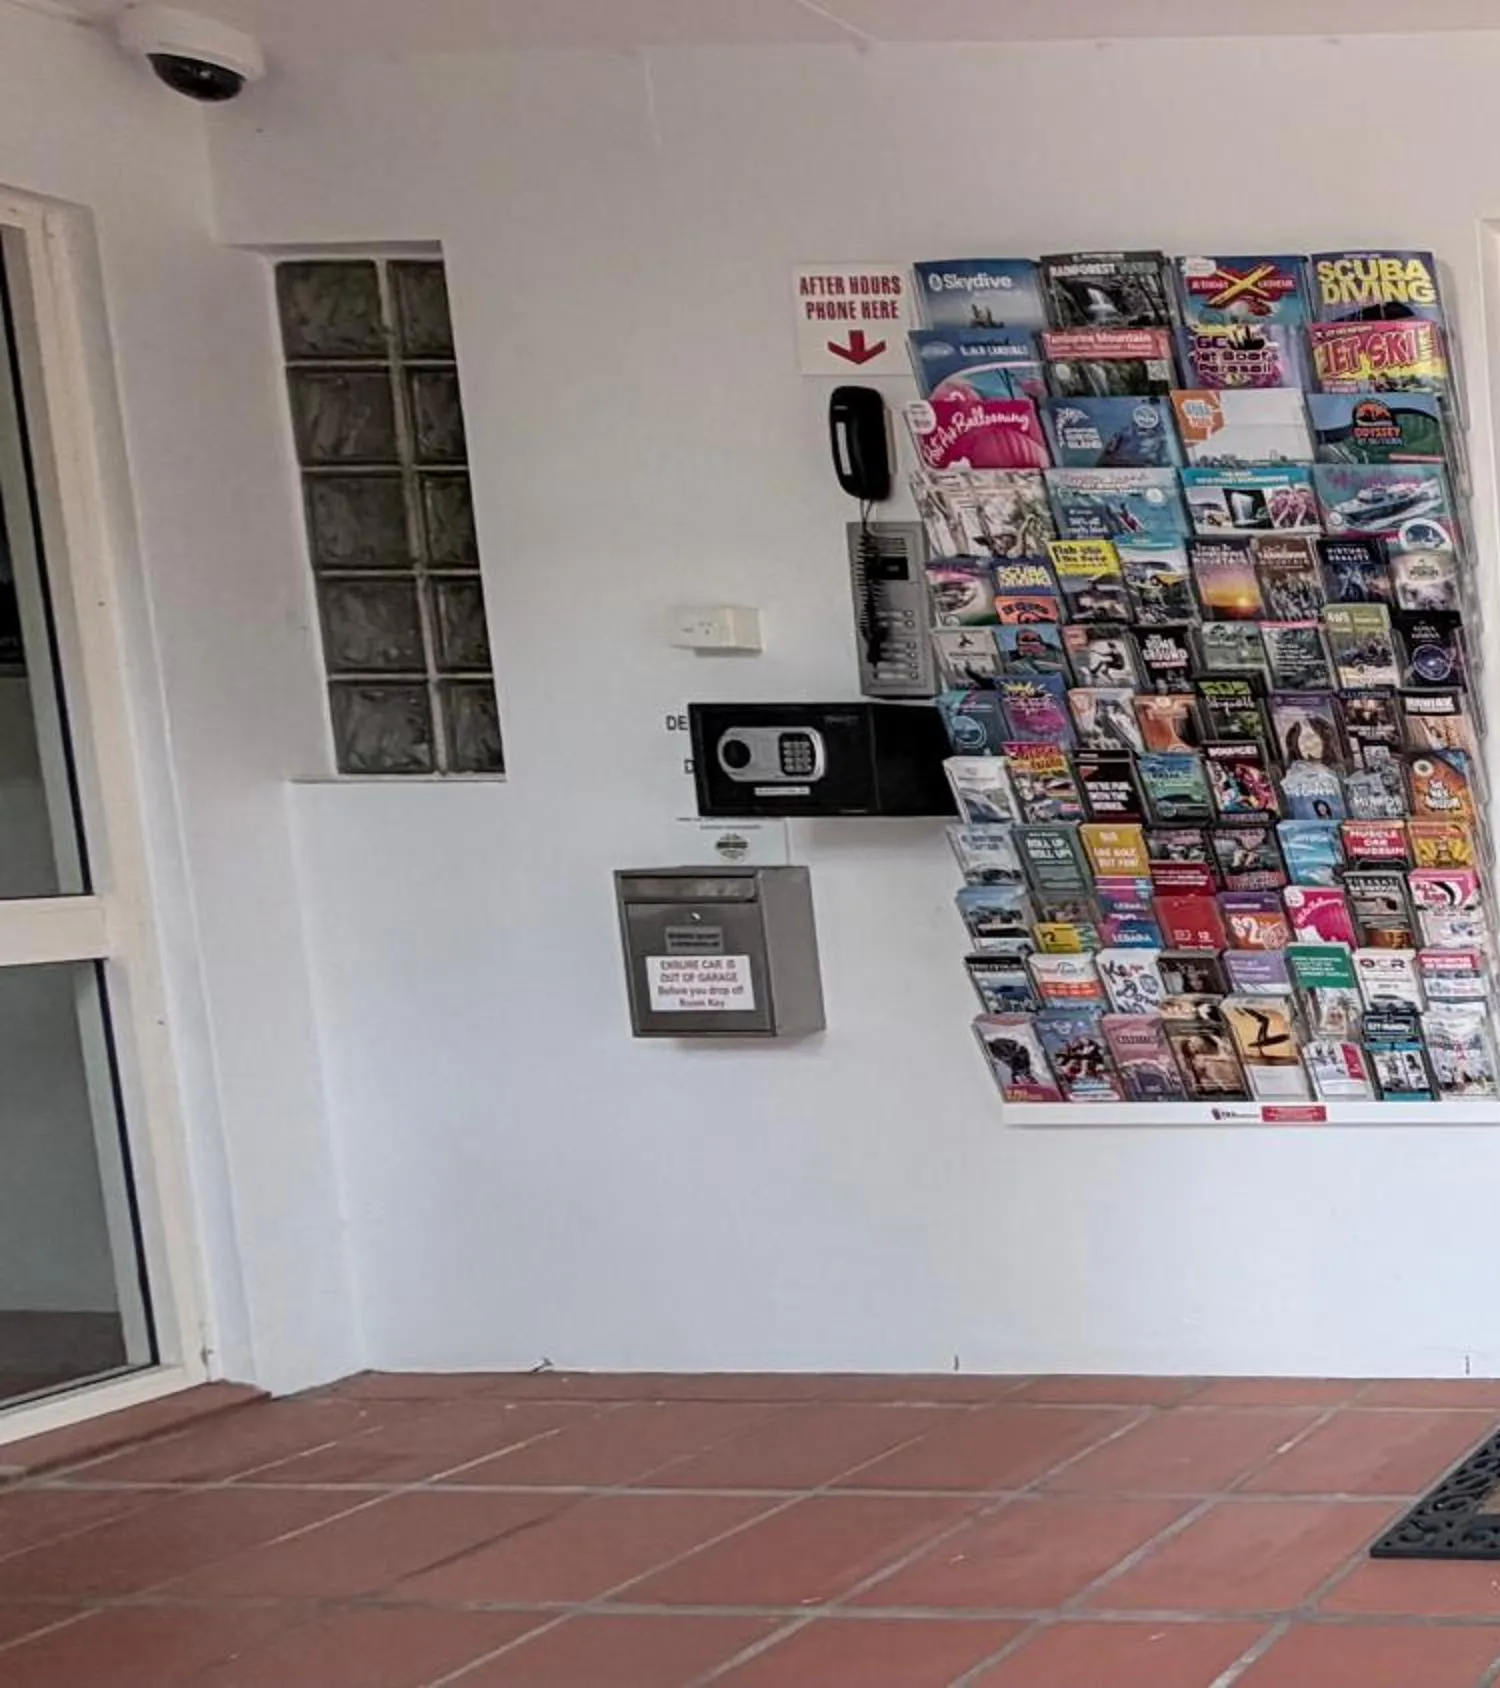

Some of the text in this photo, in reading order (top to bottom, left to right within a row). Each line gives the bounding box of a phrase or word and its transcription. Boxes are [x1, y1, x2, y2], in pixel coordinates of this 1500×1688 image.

[1317, 259, 1430, 282] SCUBA
[800, 275, 901, 296] AFTER HOURS
[944, 273, 1012, 292] Skydive
[1321, 280, 1435, 305] DIVING
[806, 300, 899, 320] PHONE HERE
[1323, 330, 1418, 377] JET SKI
[702, 960, 723, 969] CAR
[726, 959, 737, 969] IS
[660, 972, 738, 983] OUT OF GARAGE
[658, 985, 745, 997] Before you drop off
